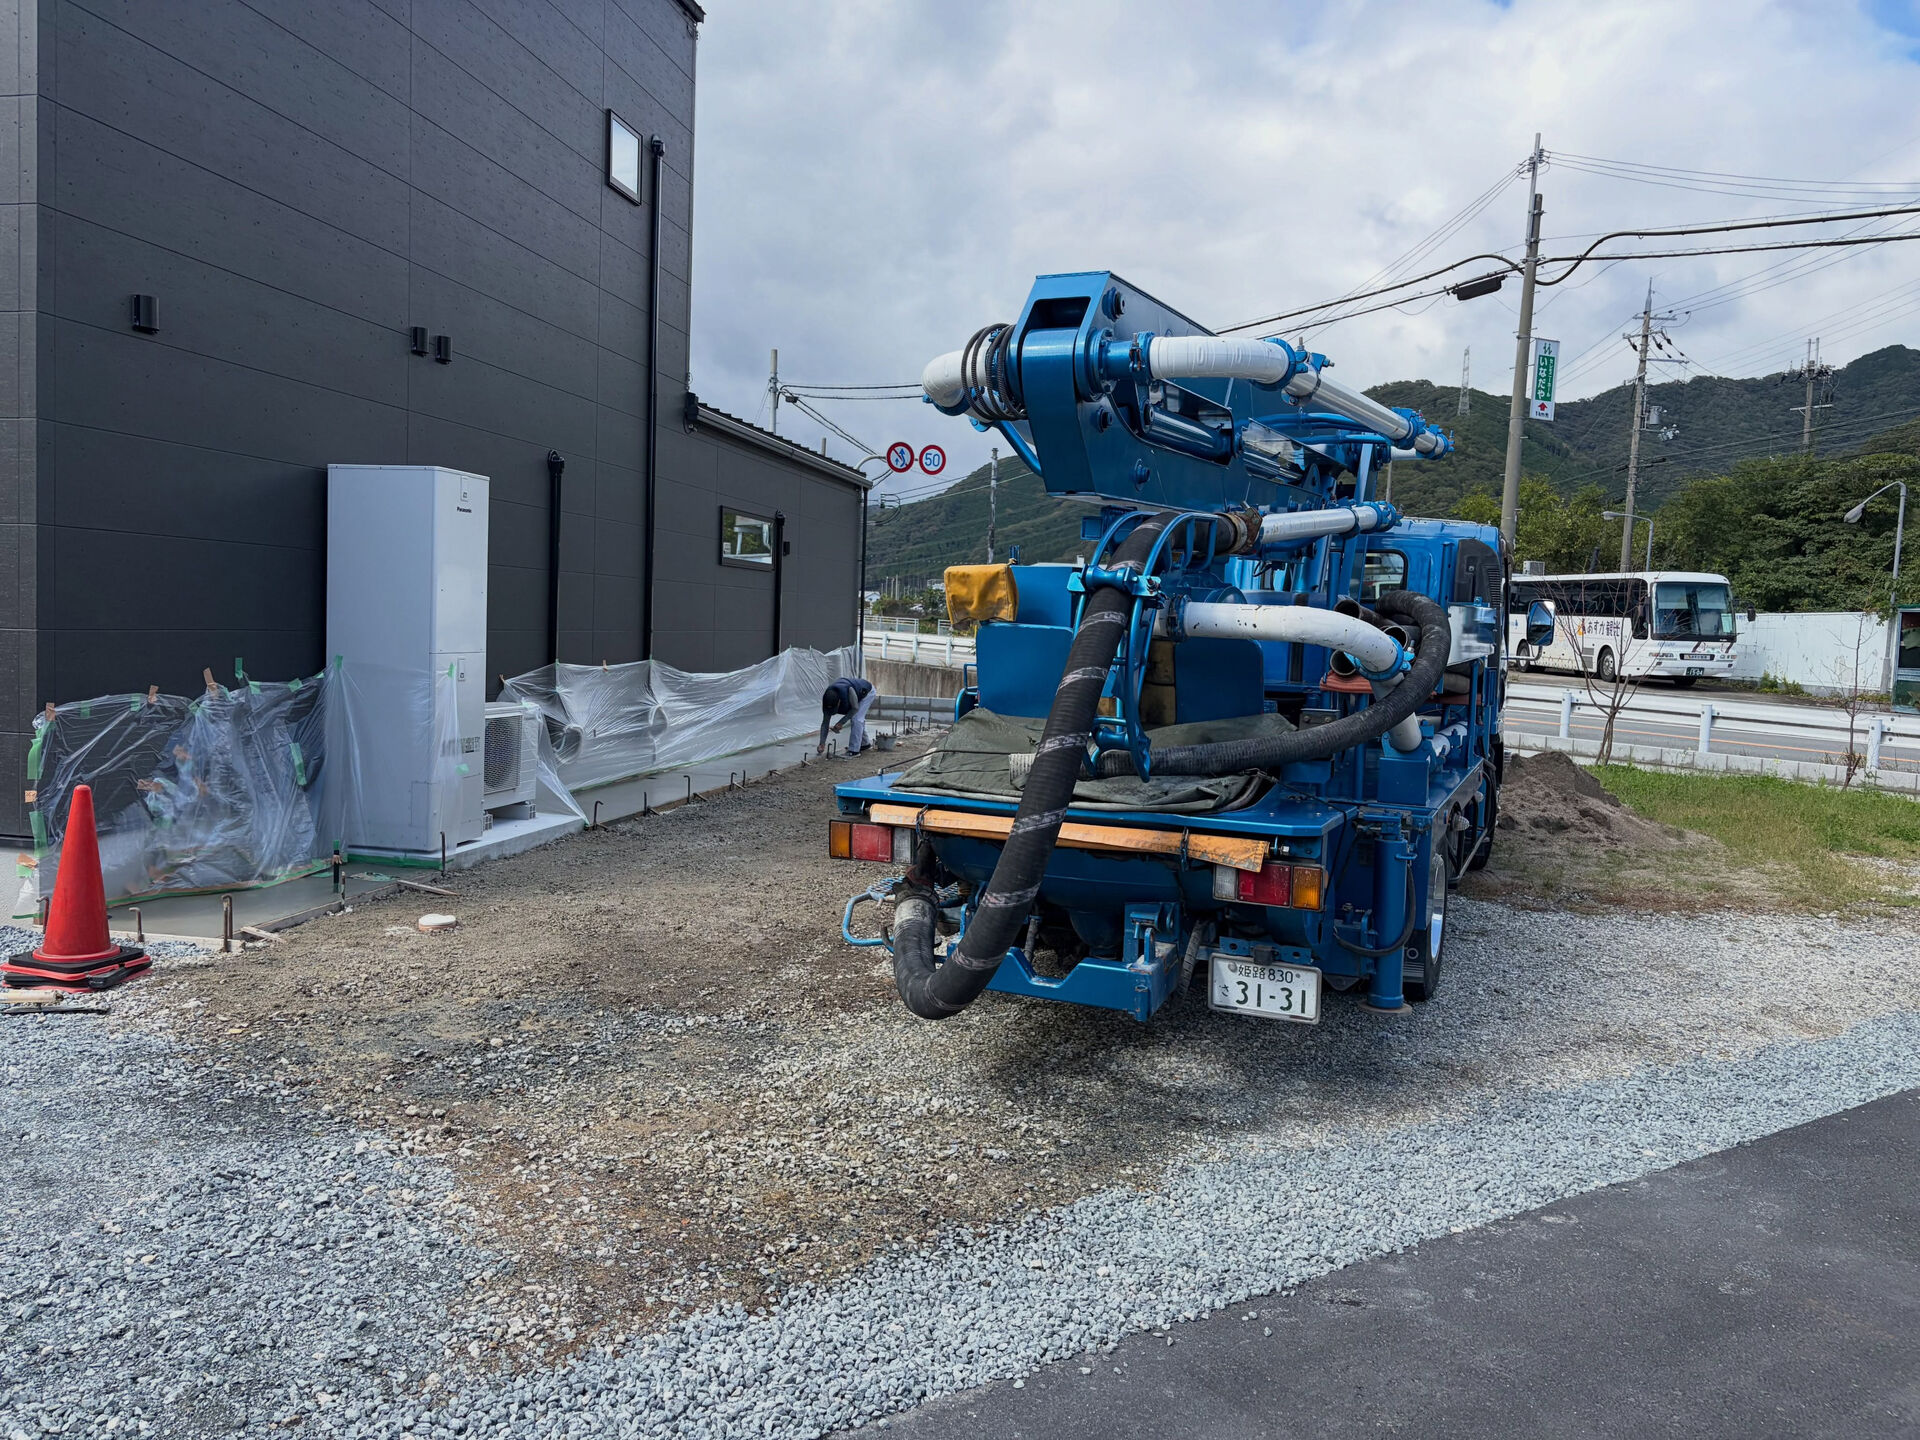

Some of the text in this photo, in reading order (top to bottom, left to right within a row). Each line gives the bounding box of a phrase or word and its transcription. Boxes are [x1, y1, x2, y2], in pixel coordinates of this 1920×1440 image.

[1537, 356, 1548, 400] いなだや
[924, 452, 941, 467] 50
[1235, 980, 1306, 1014] 31-31
